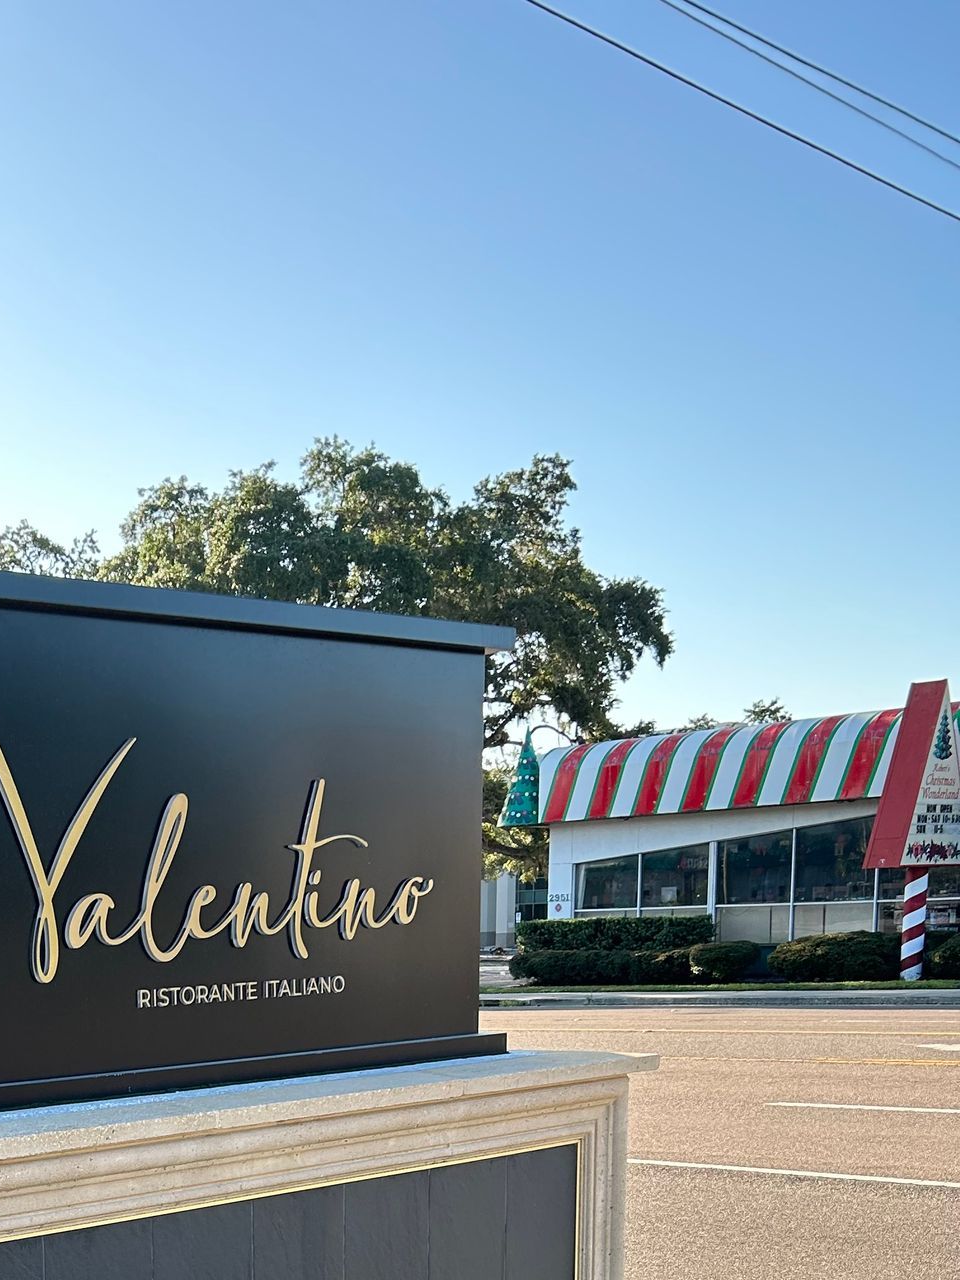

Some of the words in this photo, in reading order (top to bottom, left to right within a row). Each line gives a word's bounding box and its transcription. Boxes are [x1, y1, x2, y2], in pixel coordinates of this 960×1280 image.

[926, 773, 956, 786] Christmas
[921, 787, 960, 800] Wonderland
[940, 804, 953, 813] OPEN
[549, 893, 569, 902] 2951
[137, 981, 258, 1009] RISTORANTE
[263, 975, 345, 998] ITALIANO
